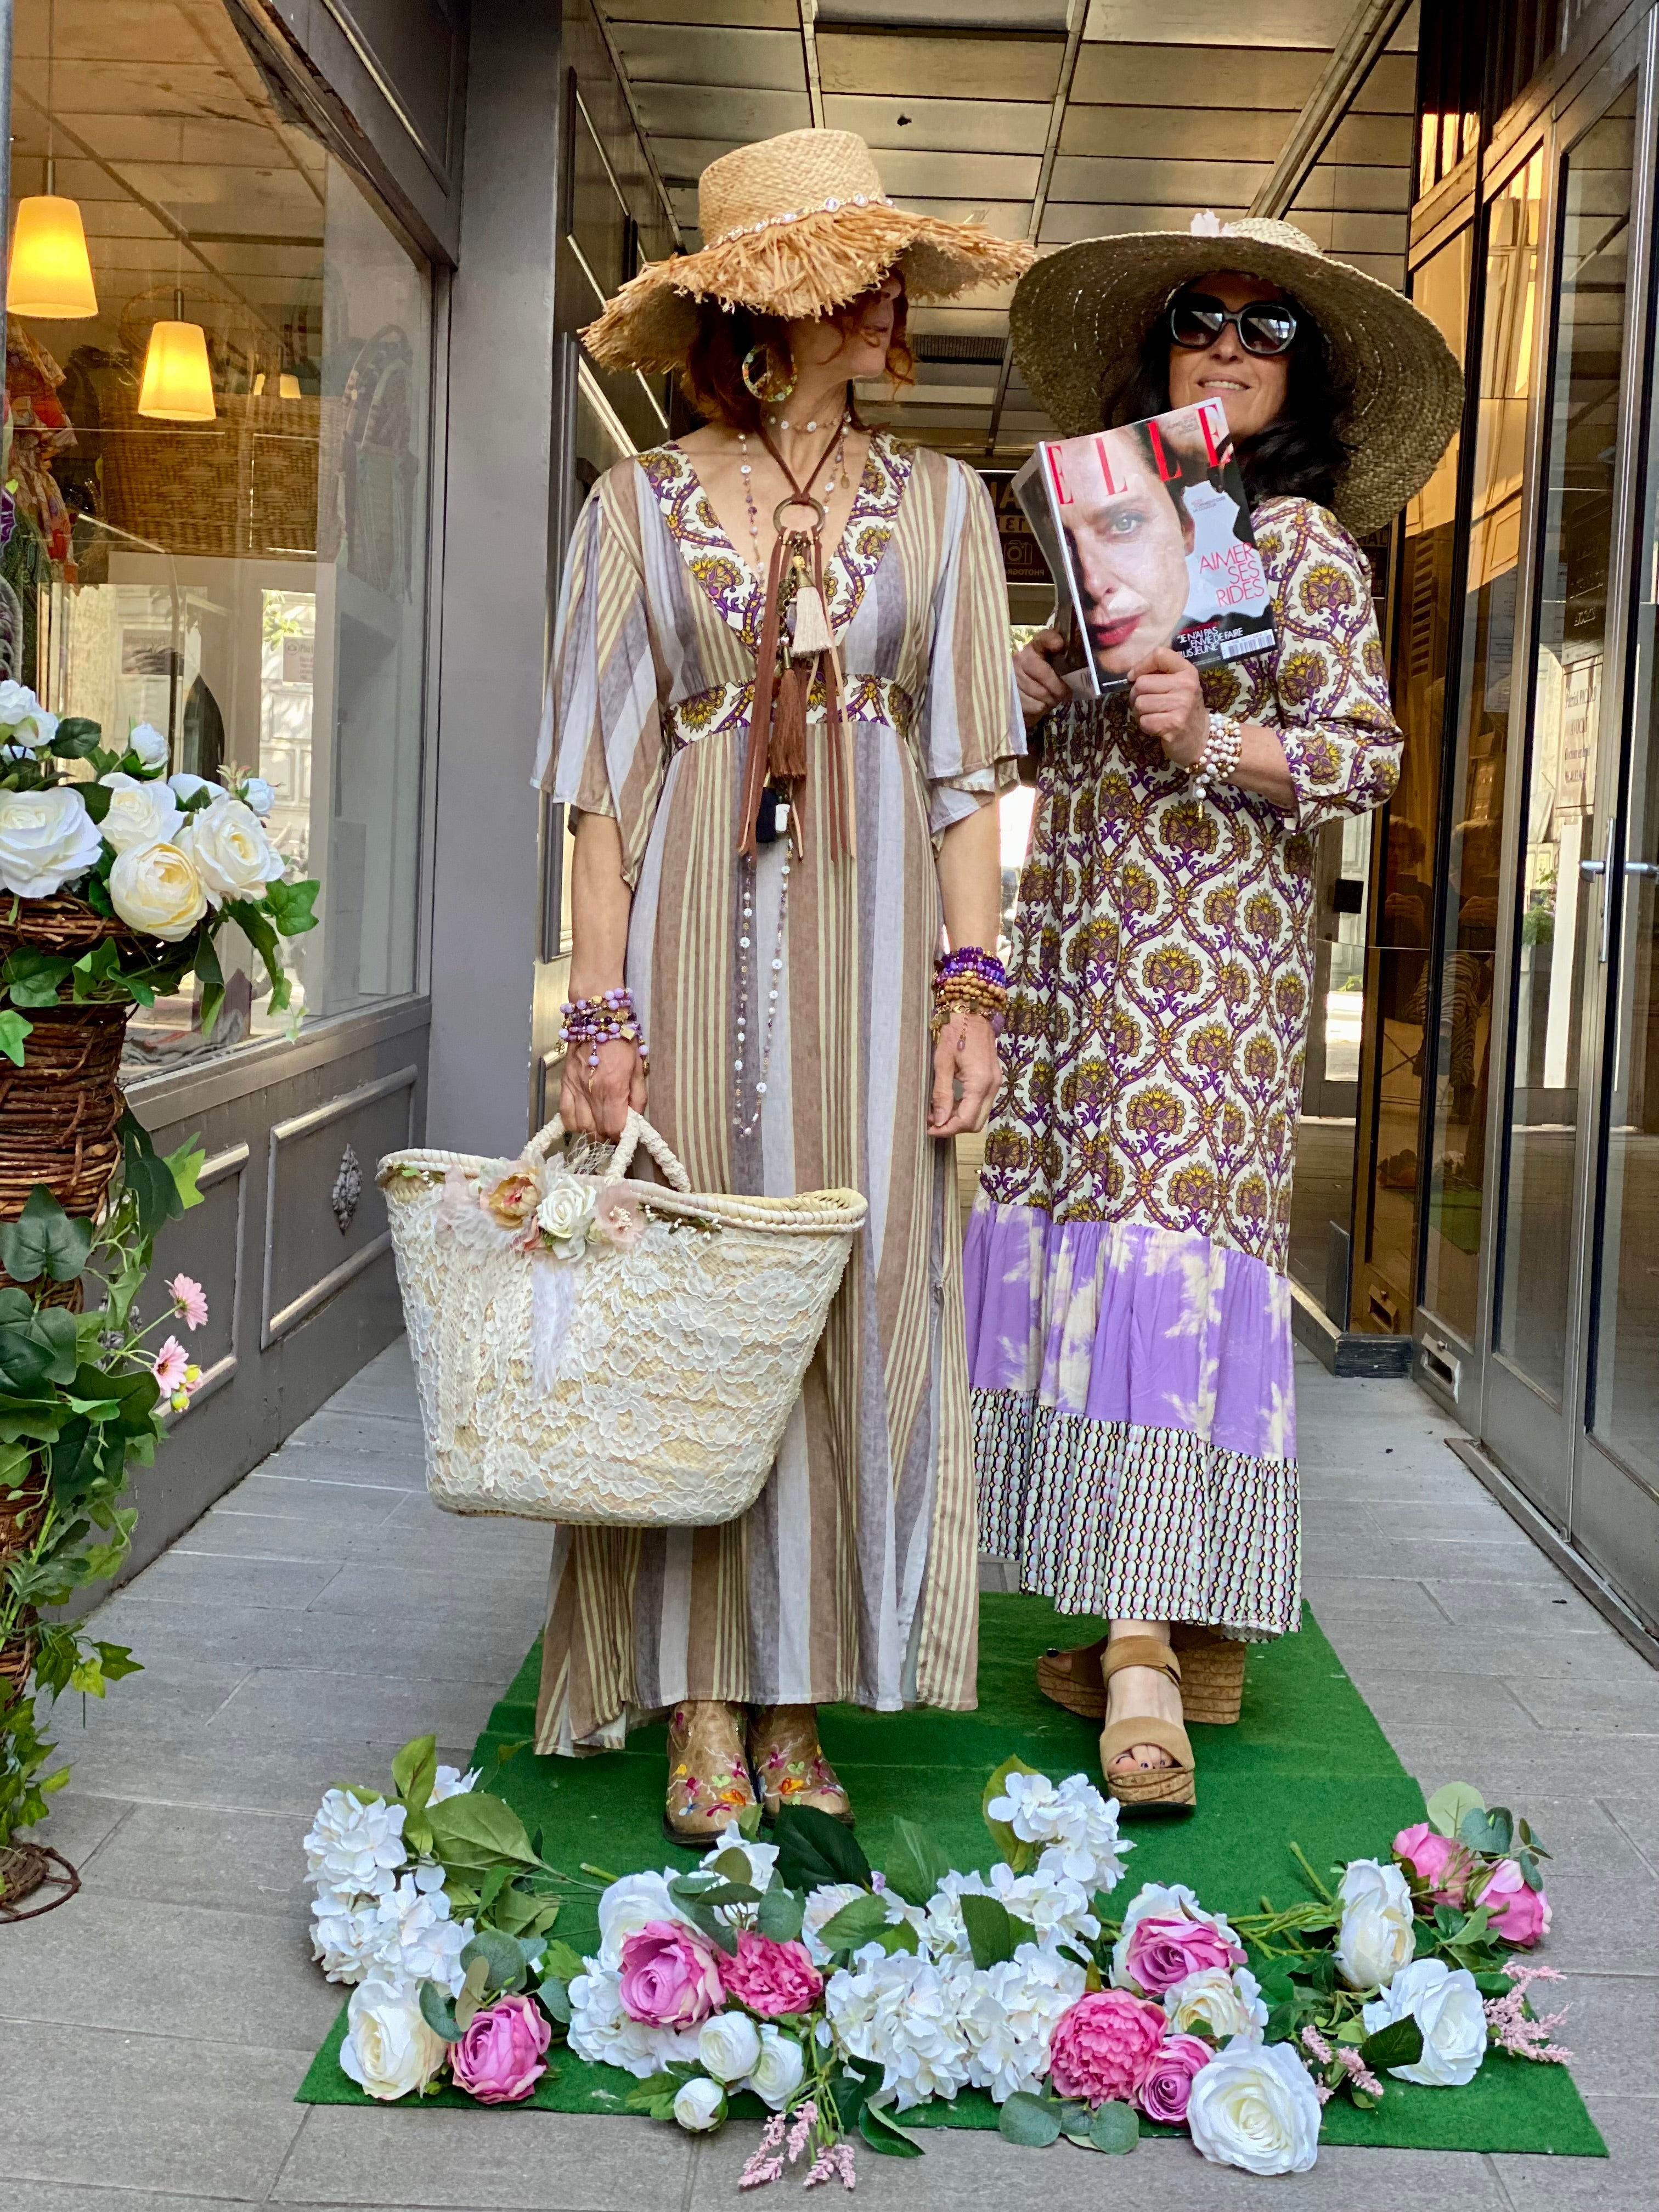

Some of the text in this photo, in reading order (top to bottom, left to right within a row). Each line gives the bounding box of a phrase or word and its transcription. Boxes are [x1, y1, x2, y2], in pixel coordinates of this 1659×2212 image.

[1046, 404, 1231, 505] ELLE
[1200, 542, 1255, 574] AIMER
[1228, 560, 1260, 584] SES
[1216, 578, 1265, 608] RIDES
[1203, 627, 1218, 637] PAS
[1212, 633, 1224, 642] DE
[1224, 627, 1244, 640] FAIRE
